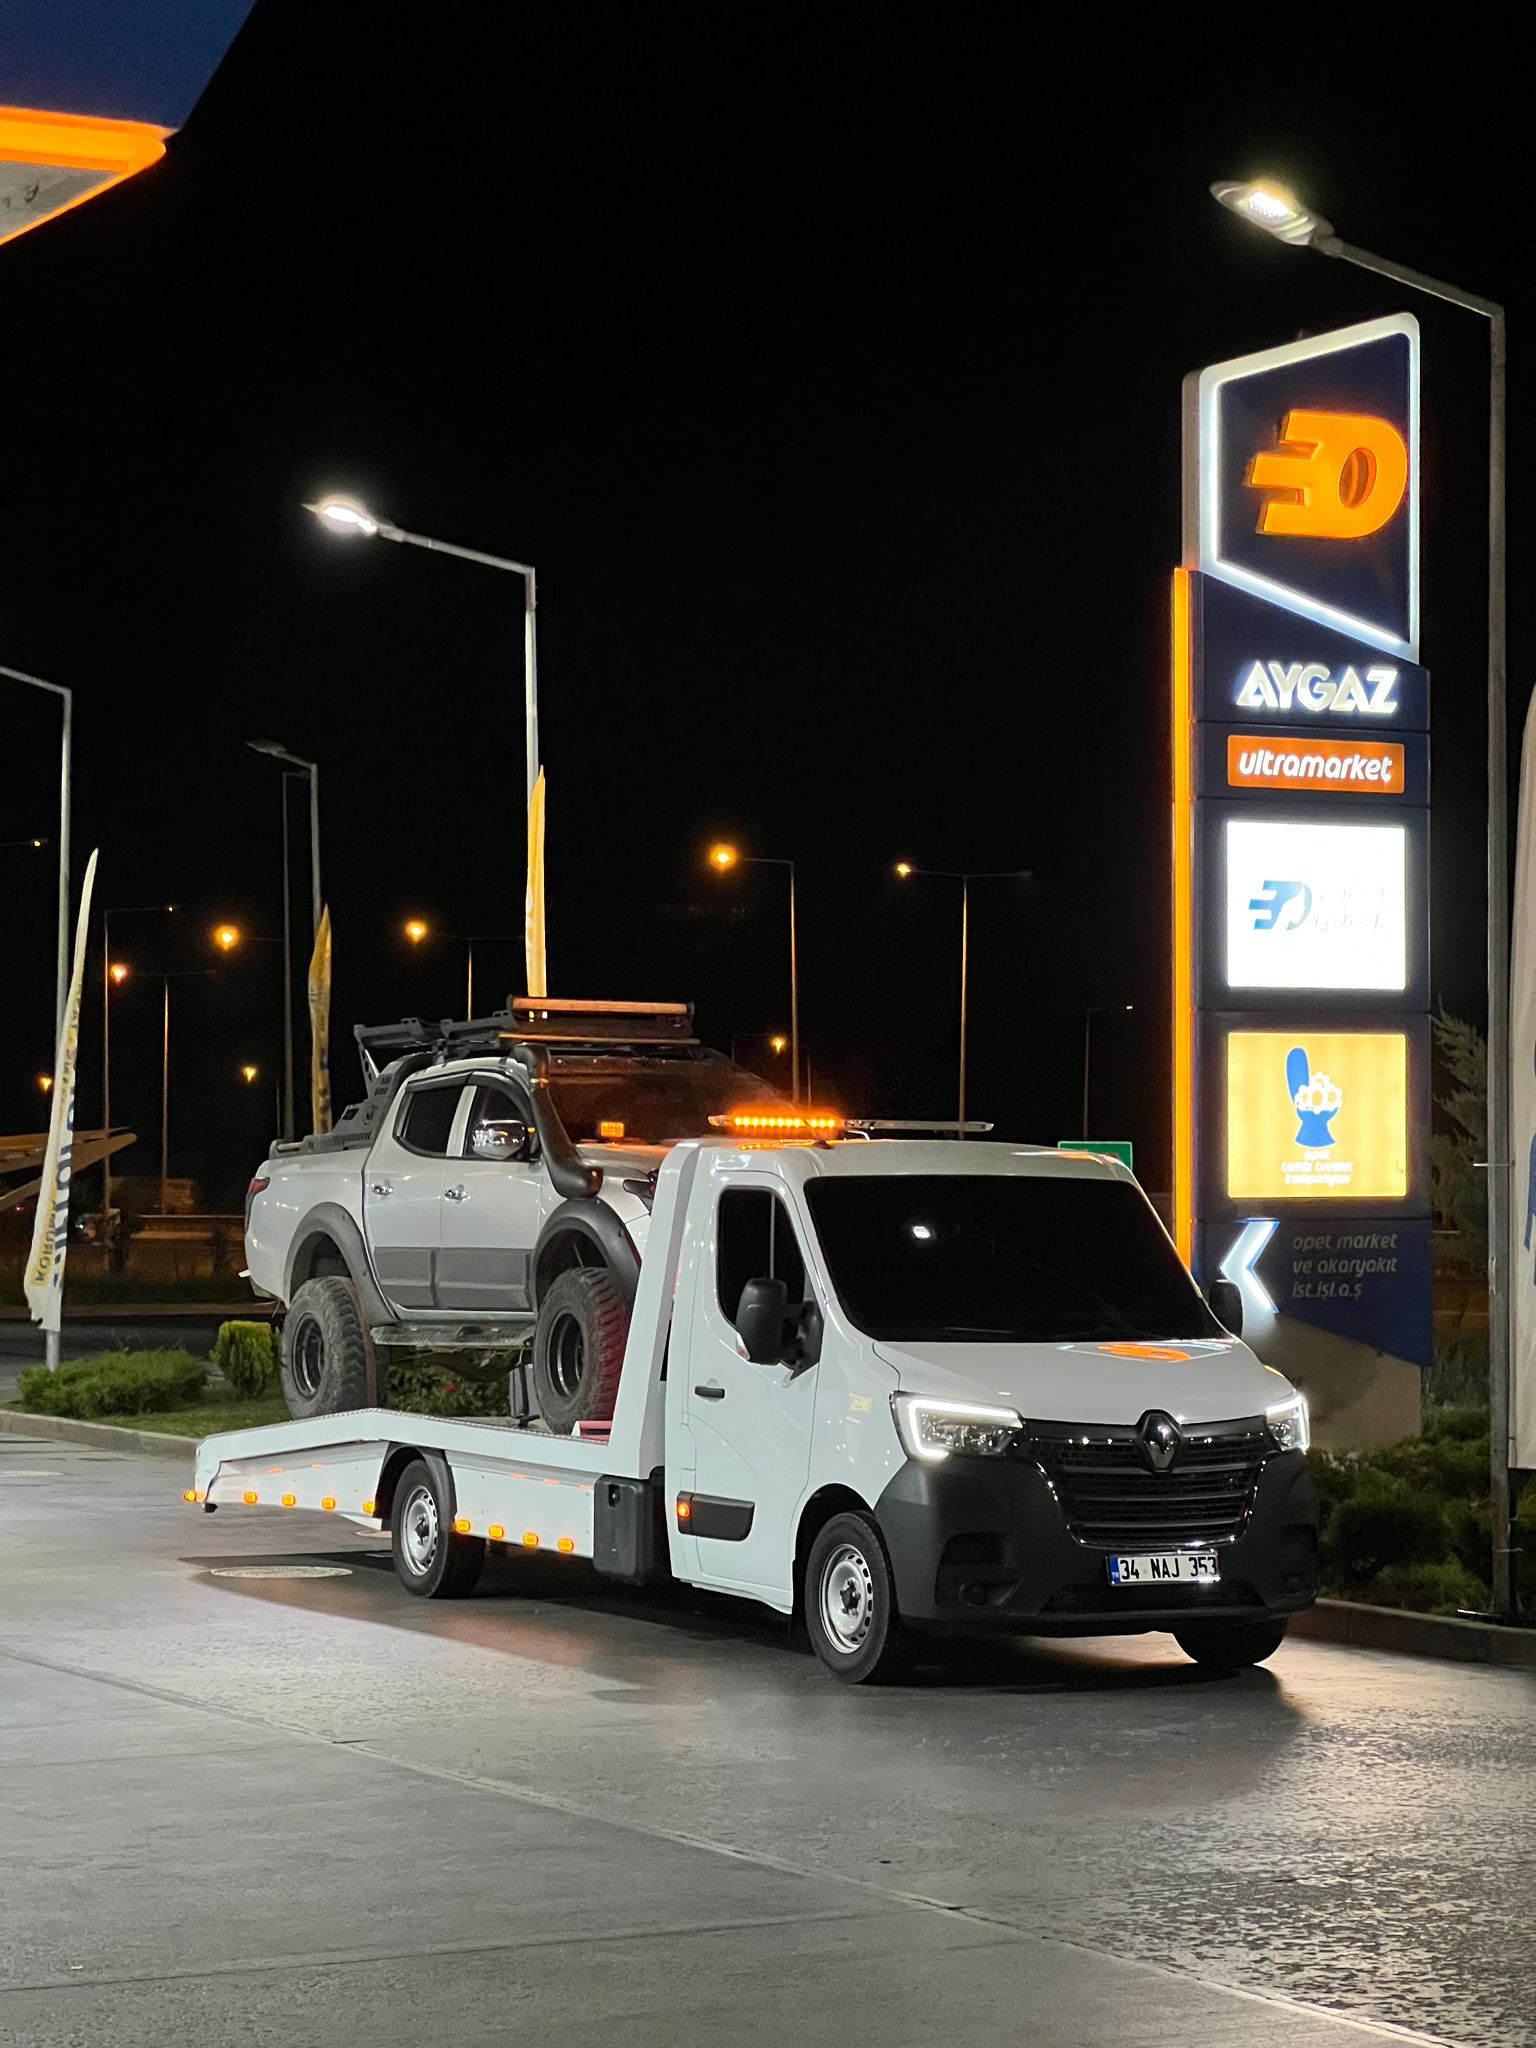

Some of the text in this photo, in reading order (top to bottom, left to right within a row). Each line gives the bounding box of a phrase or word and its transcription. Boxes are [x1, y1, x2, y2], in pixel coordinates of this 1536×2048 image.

[1236, 660, 1398, 714] AYGAZ
[1239, 749, 1393, 782] ultramarket
[1292, 1233, 1399, 1251] opet market
[1292, 1256, 1399, 1278] ve akaryakıt
[1119, 1556, 1217, 1580] 34 NAJ 353
